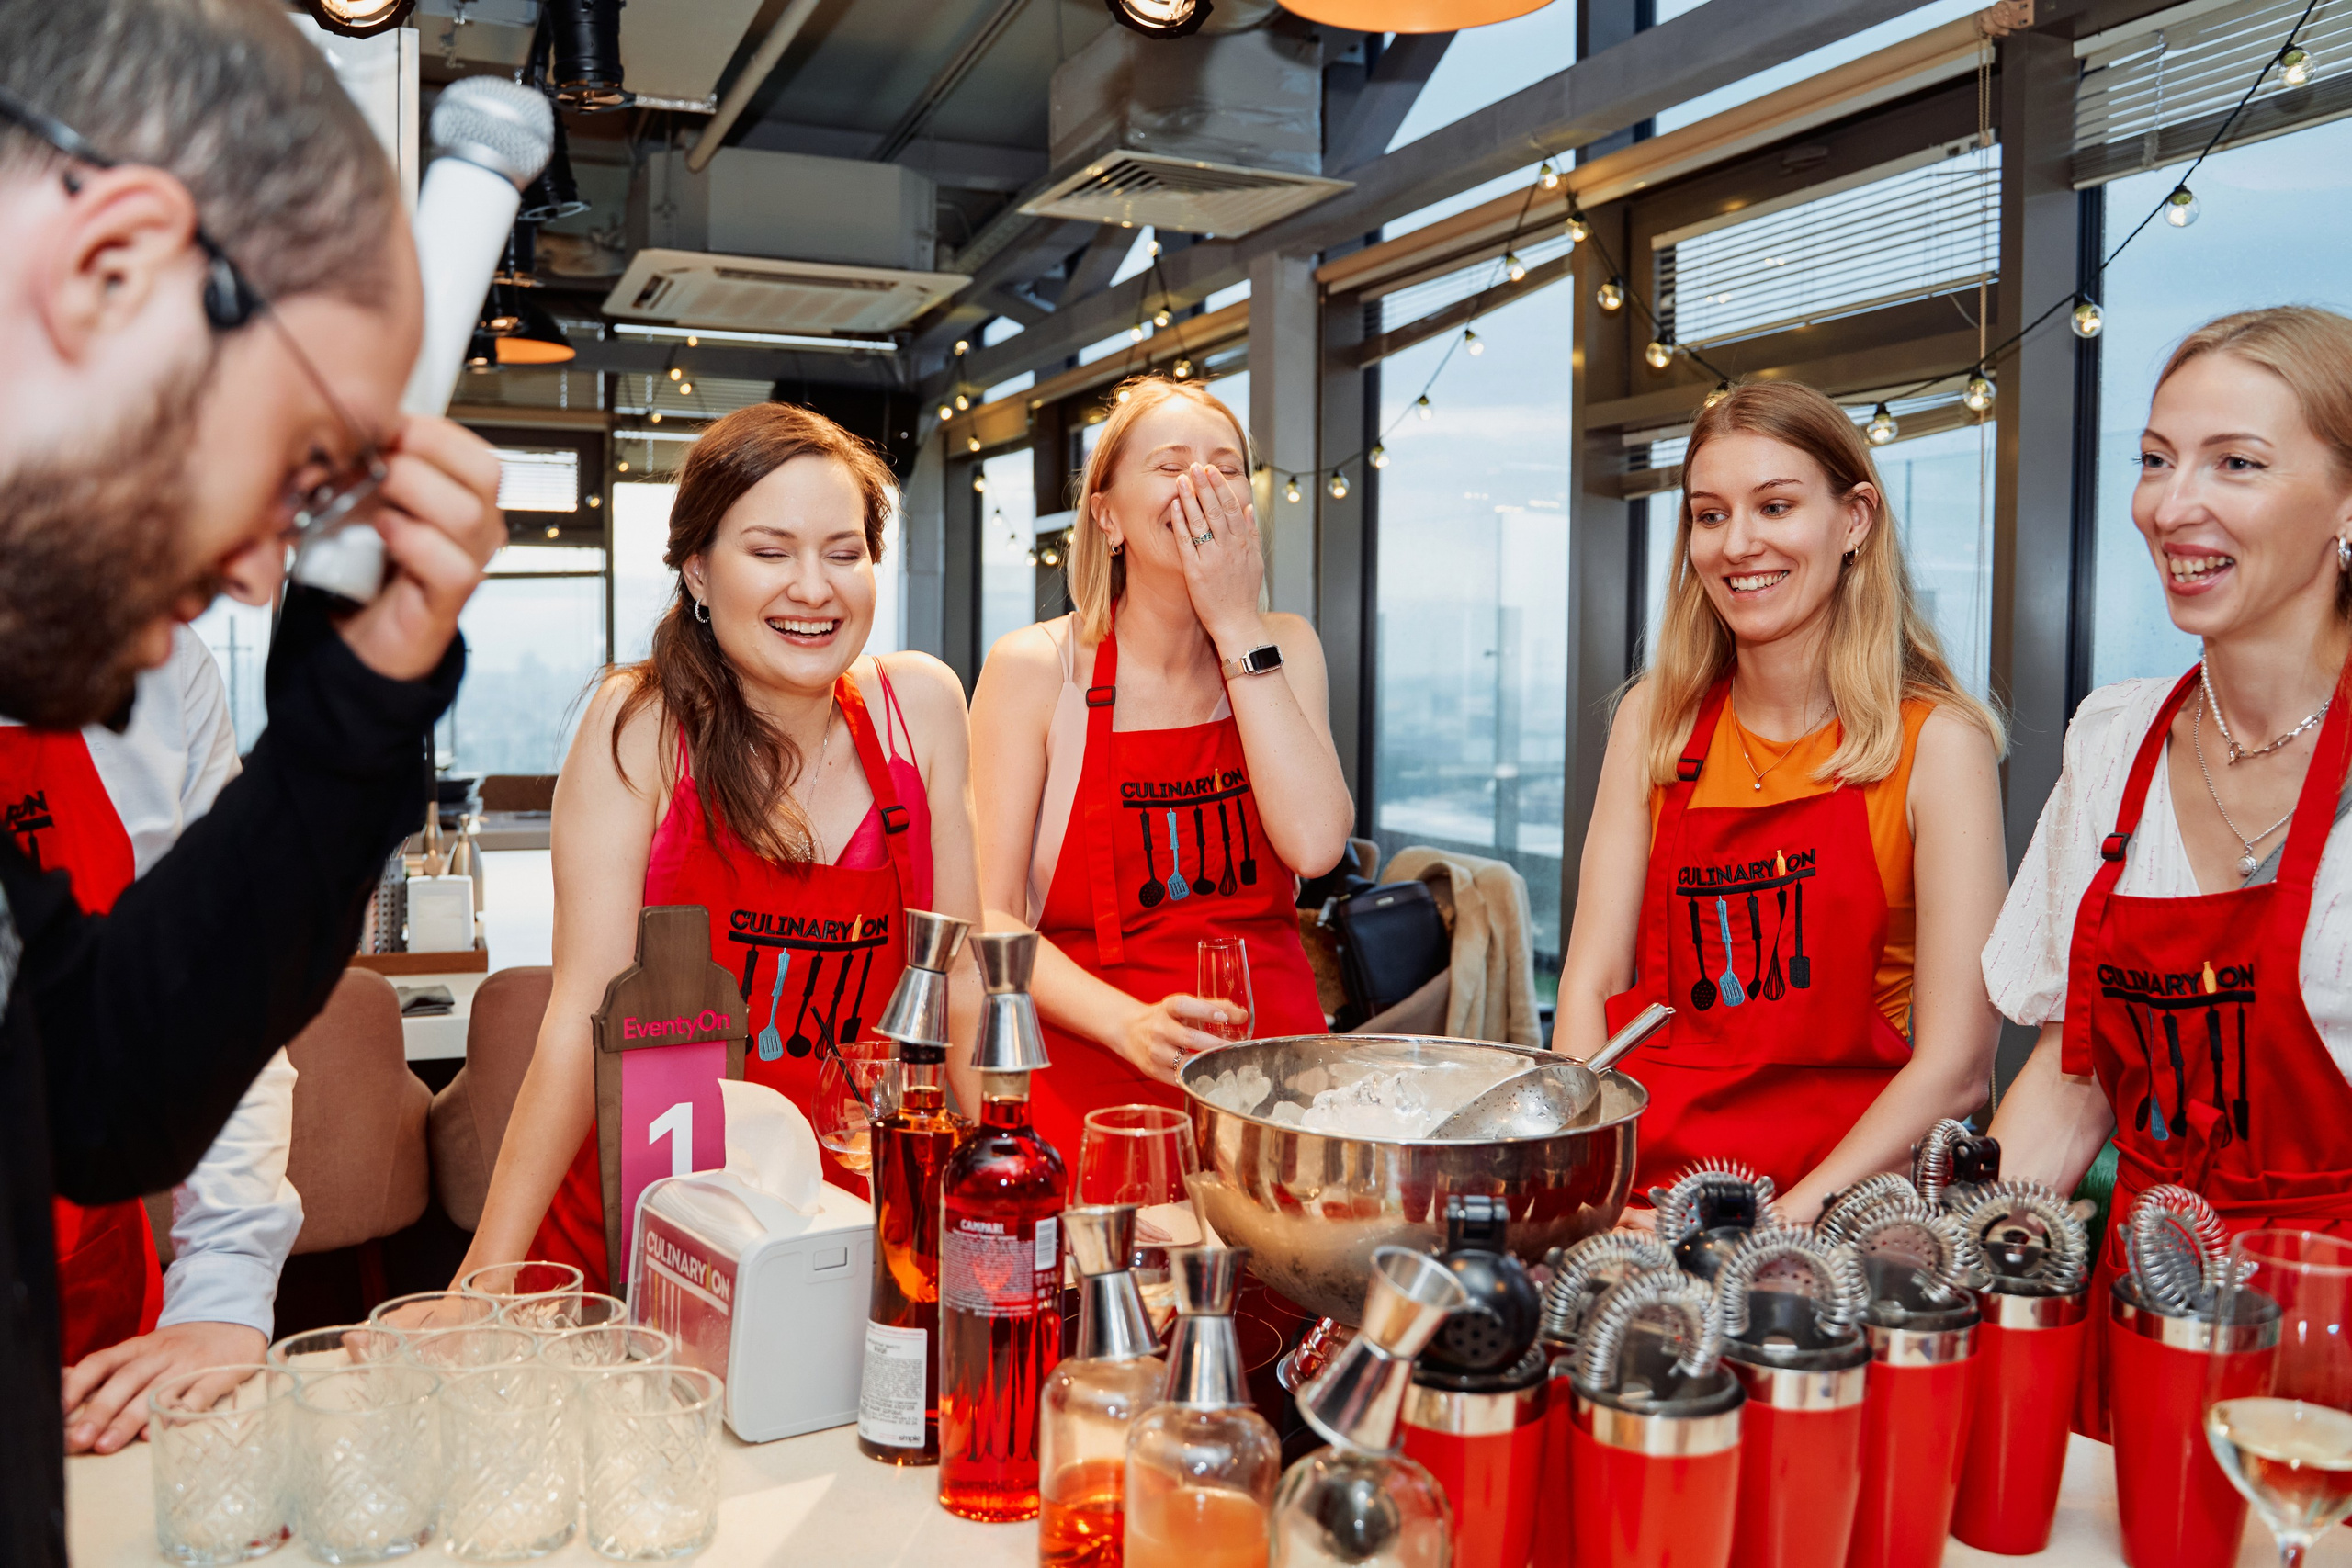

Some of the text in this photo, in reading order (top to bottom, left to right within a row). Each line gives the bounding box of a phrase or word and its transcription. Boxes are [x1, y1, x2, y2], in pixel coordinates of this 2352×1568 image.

[1120, 767, 1246, 799] CULINARY ON
[1678, 848, 1816, 886] CULINARY ON
[730, 909, 888, 941] CULINARY ON
[2097, 963, 2255, 996] CULINARY ON
[623, 1010, 731, 1040] EventyOn
[649, 1101, 693, 1178] 1
[646, 1230, 729, 1302] CULINARY ON
